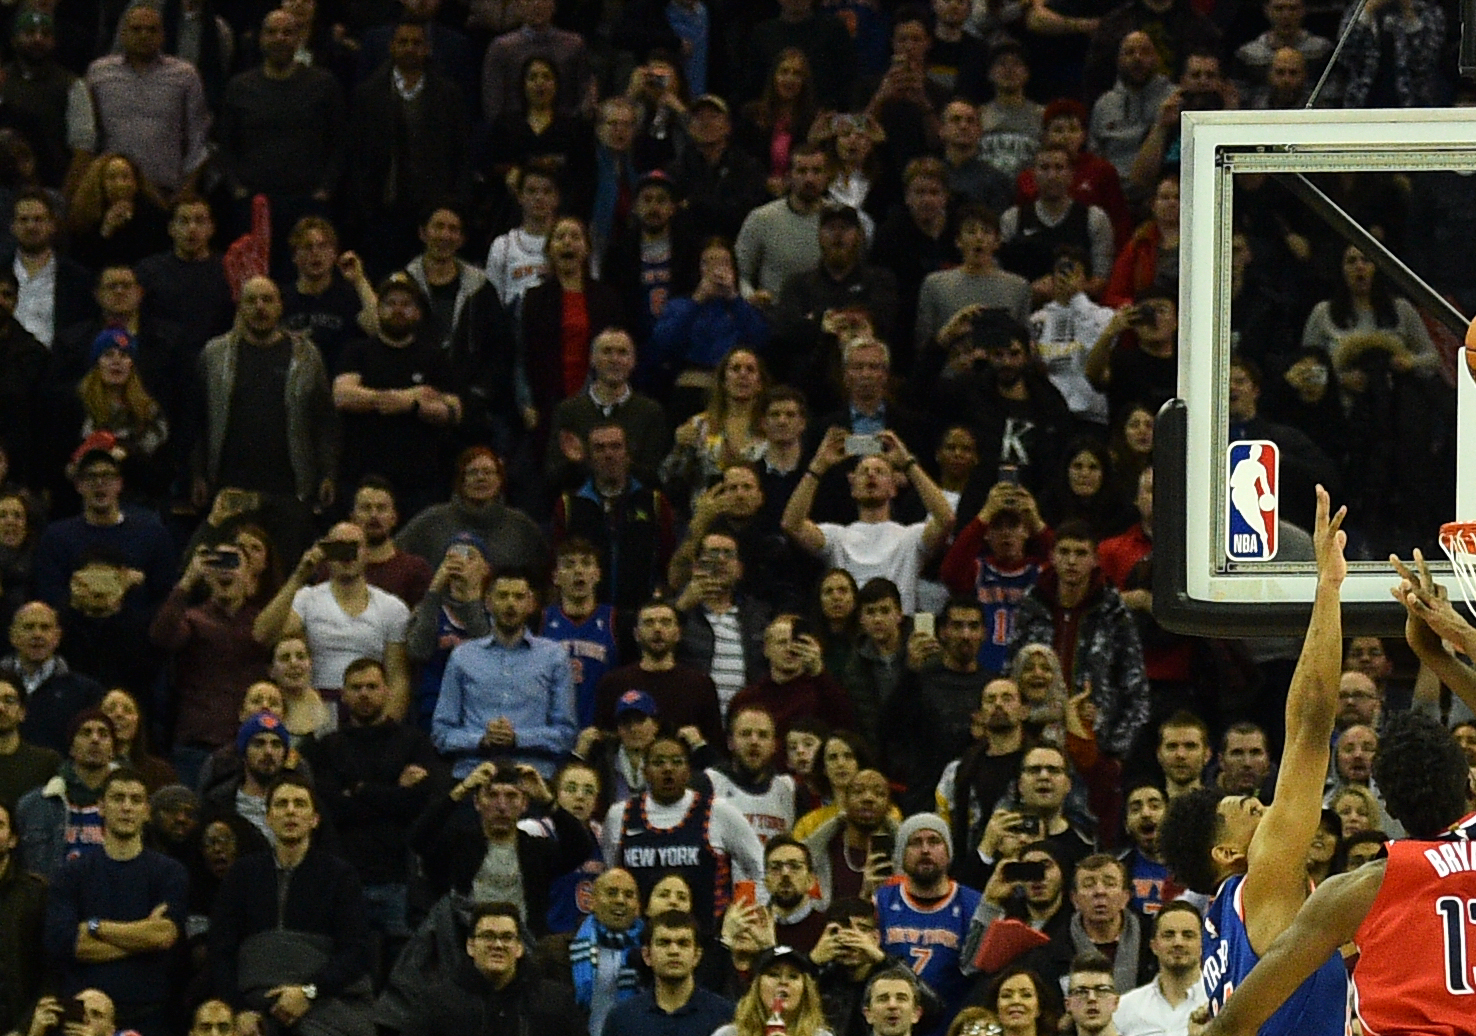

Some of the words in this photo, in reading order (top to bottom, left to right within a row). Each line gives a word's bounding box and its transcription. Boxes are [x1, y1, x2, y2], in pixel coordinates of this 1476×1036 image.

[1233, 533, 1258, 554] NBA
[623, 847, 655, 867] NEW
[655, 846, 699, 867] YORK
